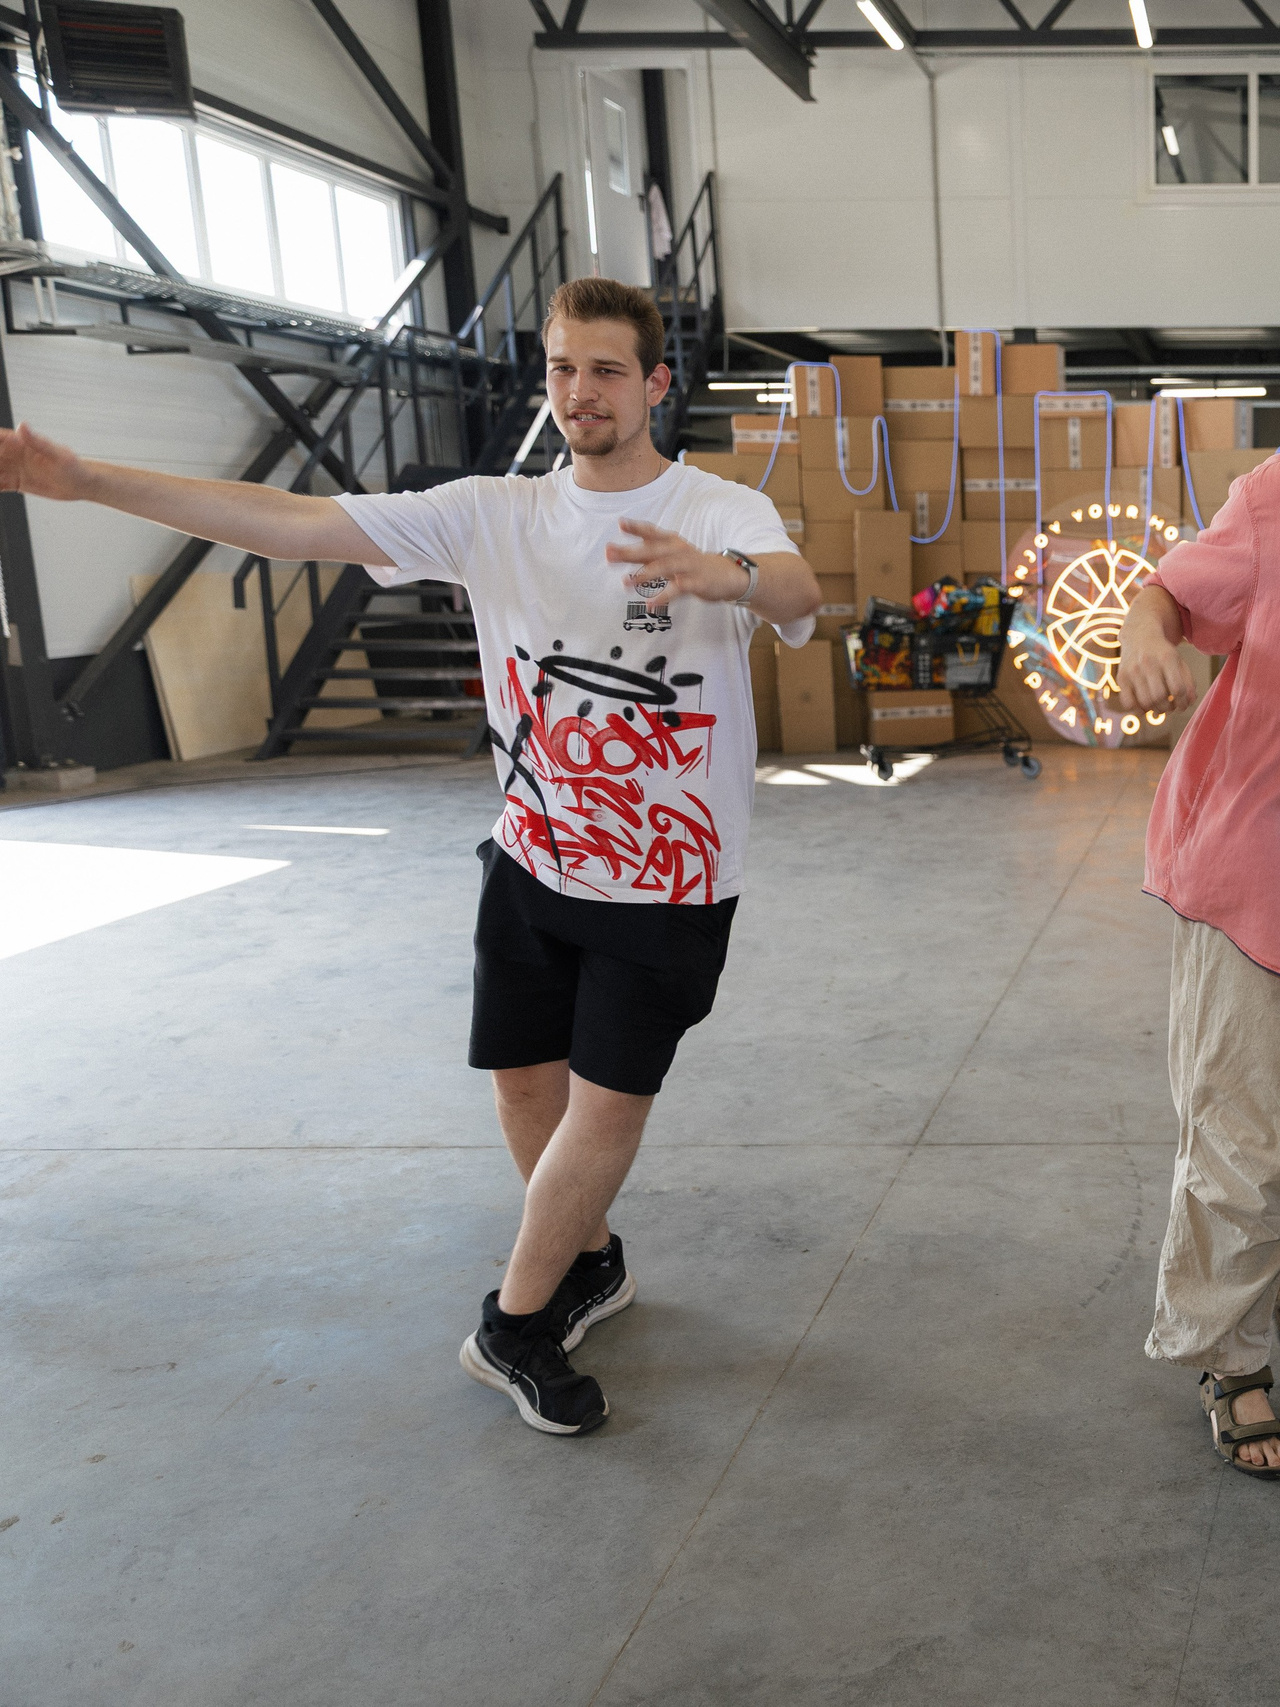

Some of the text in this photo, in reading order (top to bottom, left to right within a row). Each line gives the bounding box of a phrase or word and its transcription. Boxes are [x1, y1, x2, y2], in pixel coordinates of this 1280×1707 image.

[1008, 521, 1061, 597] ENJOY
[1071, 504, 1139, 522] YOUR
[1008, 630, 1076, 726] ALPHA
